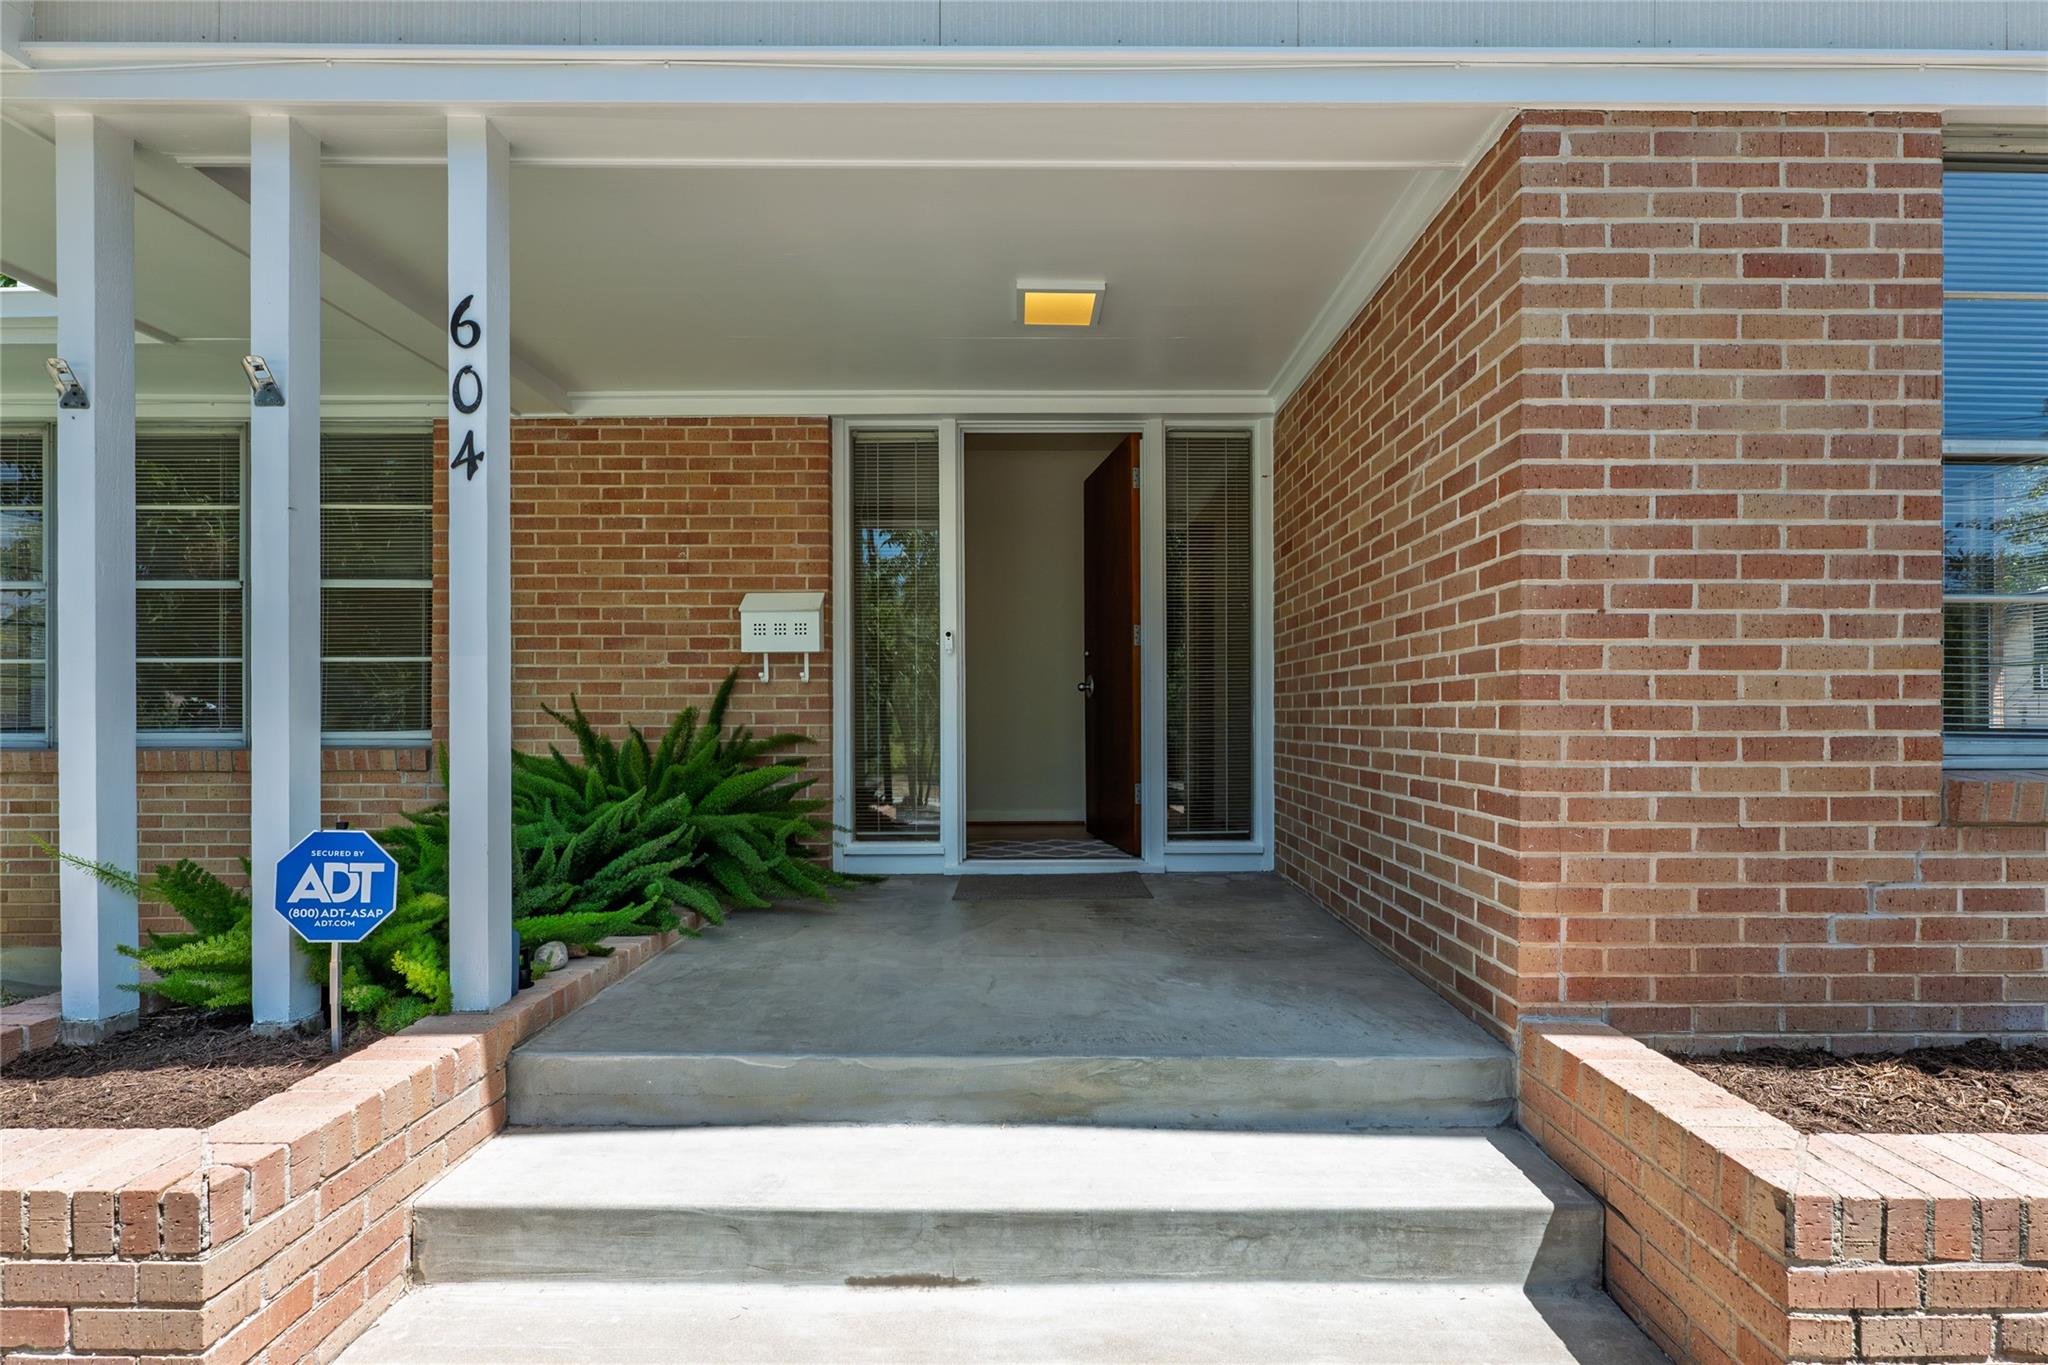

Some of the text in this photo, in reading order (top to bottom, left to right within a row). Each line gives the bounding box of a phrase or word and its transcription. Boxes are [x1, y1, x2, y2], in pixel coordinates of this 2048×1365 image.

[450, 294, 485, 481] 604
[286, 862, 385, 903] ADT
[288, 908, 384, 919] (800) ADT-ASAP
